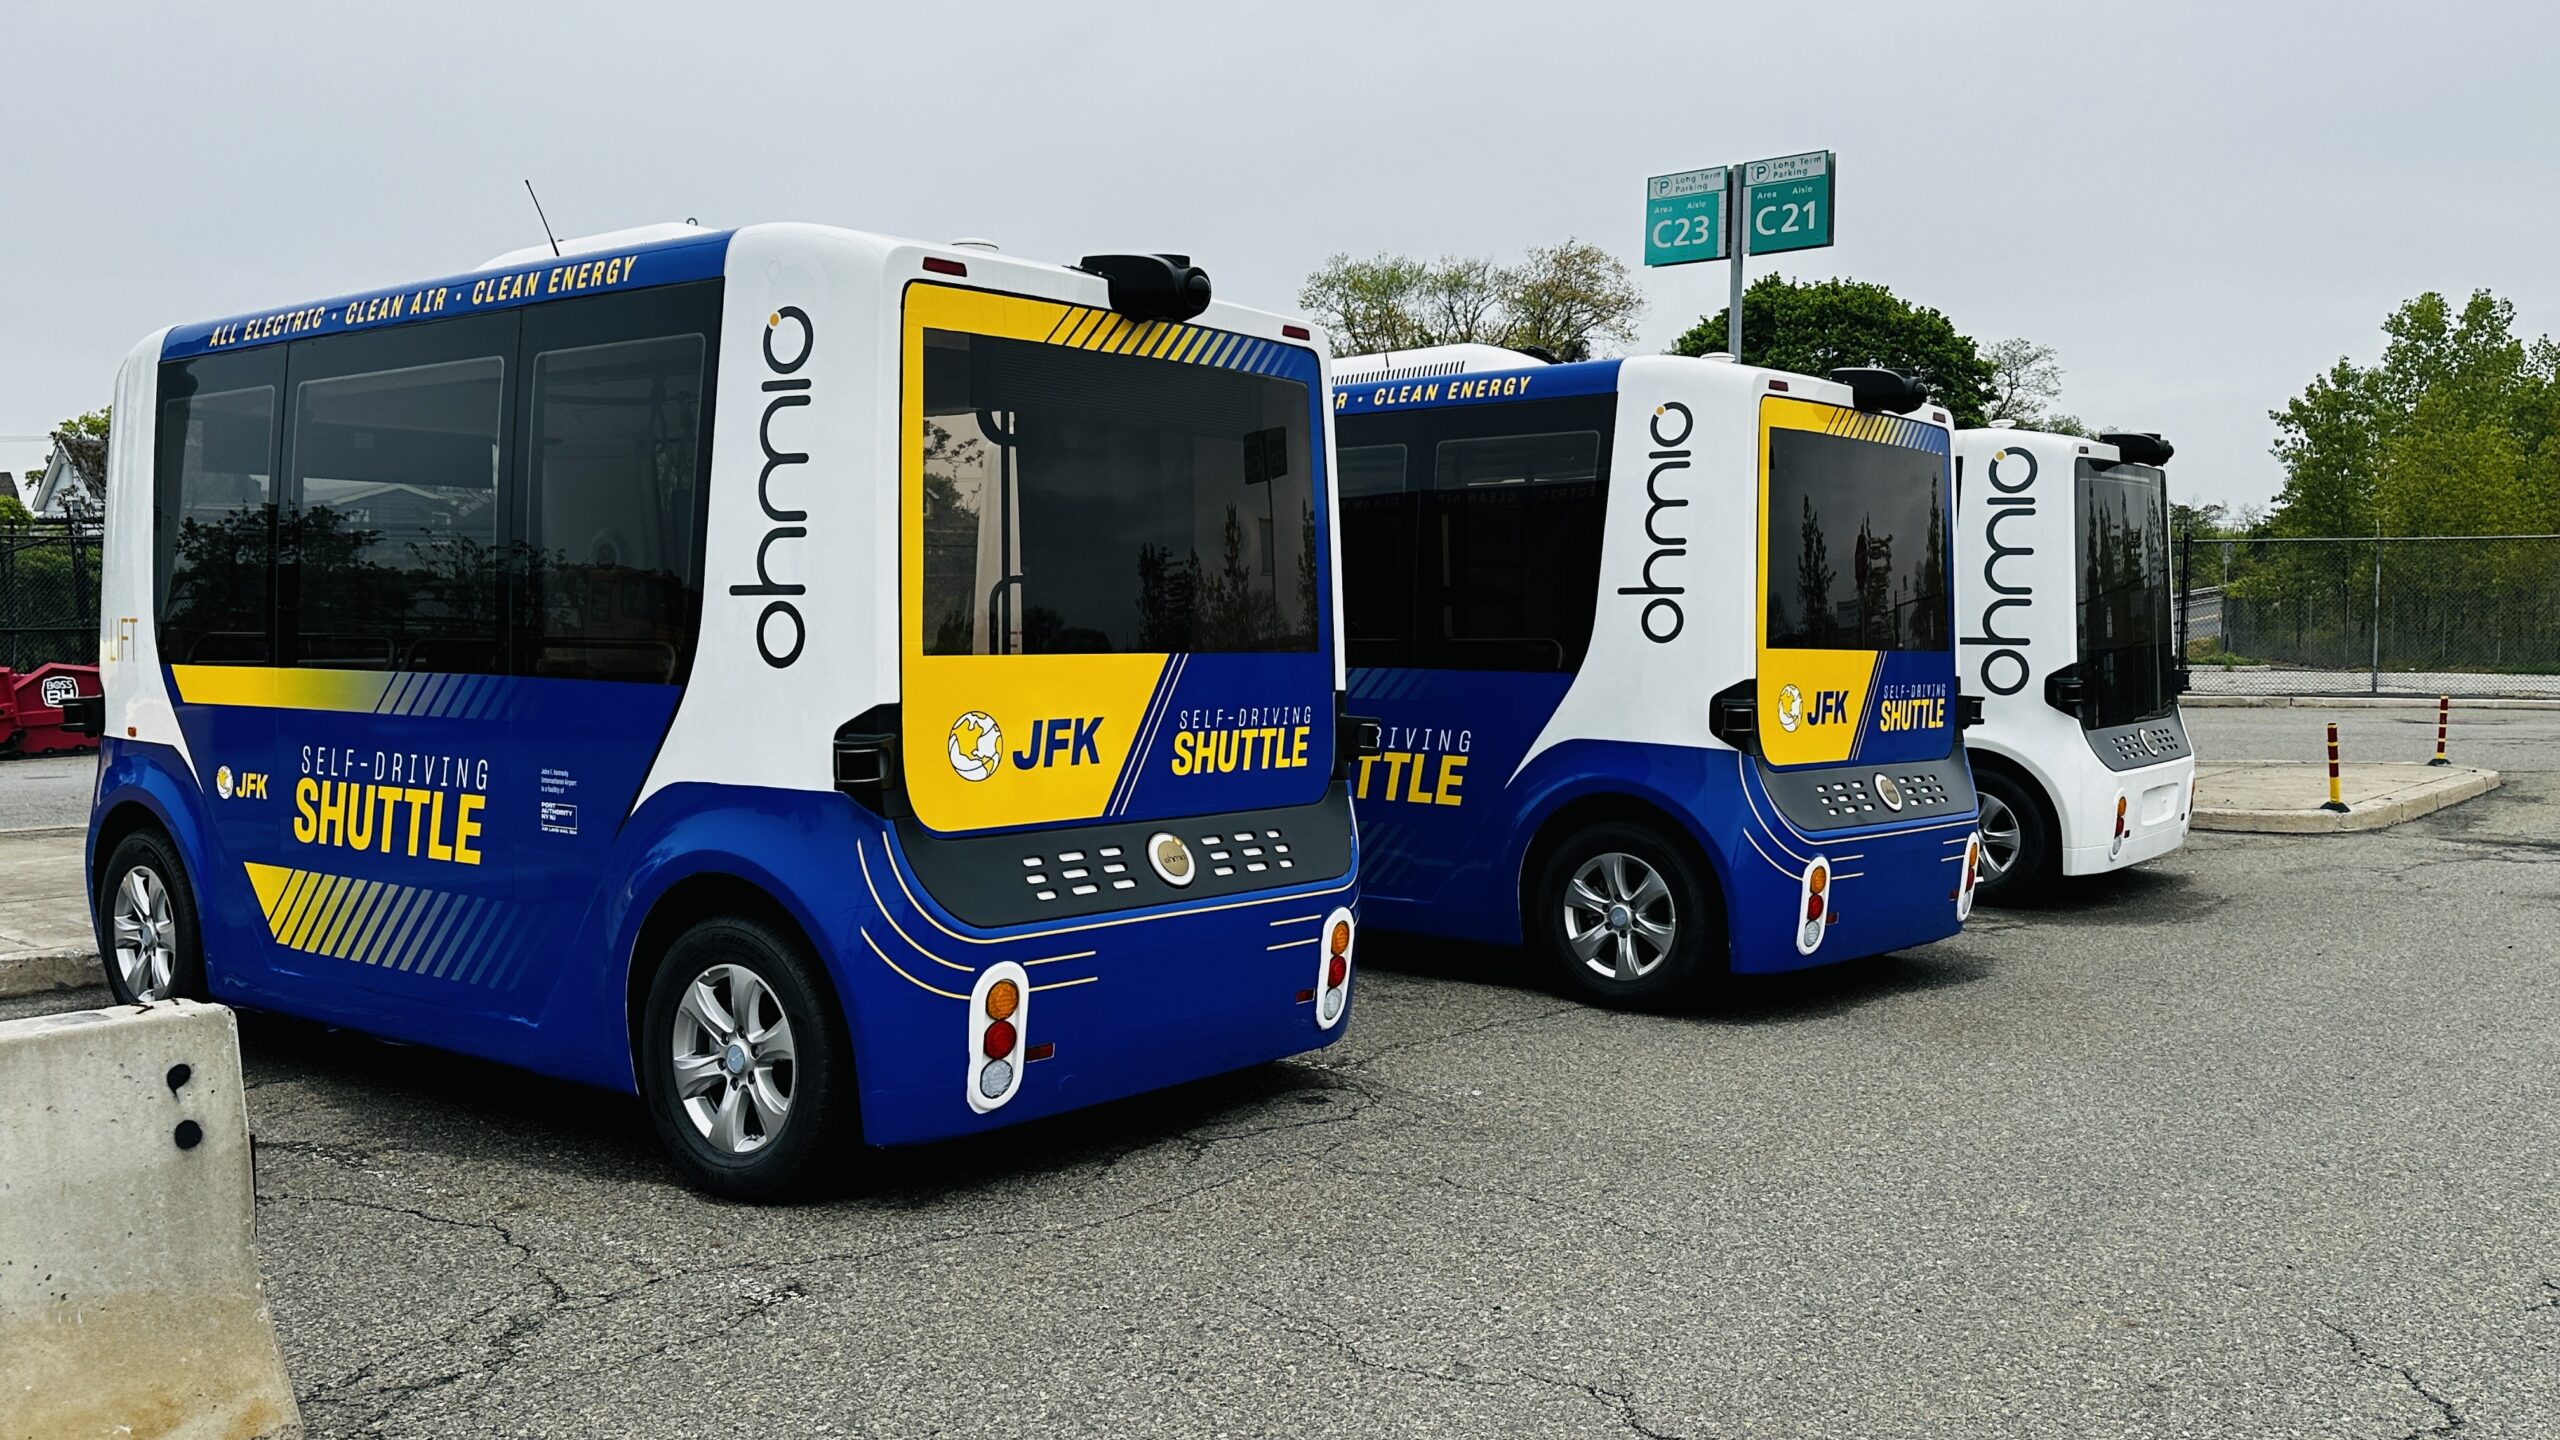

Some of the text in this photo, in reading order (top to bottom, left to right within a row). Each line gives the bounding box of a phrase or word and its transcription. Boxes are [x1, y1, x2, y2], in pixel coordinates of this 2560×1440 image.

[1675, 171, 1721, 184] Long Term
[1773, 156, 1821, 170] Long Term
[1773, 168, 1808, 178] Parking
[1675, 183, 1708, 193] Parking
[1757, 185, 1813, 200] Area Aisle
[1654, 200, 1706, 214] Area Aisle
[1755, 200, 1816, 236] C21
[1652, 215, 1710, 248] C23
[209, 255, 638, 348] ALL ELECTRIC CLEAN AIR CLEAN ENERGY
[1373, 383, 1440, 406] CLEAN
[1447, 376, 1532, 400] ENERGY
[729, 305, 814, 669] ohmio
[1617, 401, 1694, 643] ohmio
[1960, 446, 2038, 696] ohmio
[110, 618, 138, 662] LIFT
[47, 680, 73, 690] BOSS
[1883, 683, 1946, 699] SELF-DRIVING
[1179, 705, 1312, 730] SELF-DRIVING
[1807, 690, 1849, 726] JFK
[1880, 698, 1945, 732] SHUTTLE
[1012, 716, 1105, 770] JFK
[1171, 726, 1310, 777] SHUTTLE
[301, 744, 489, 791] SELF-DRIVING
[235, 772, 269, 801] JFK
[293, 777, 486, 866] SHUTTLE
